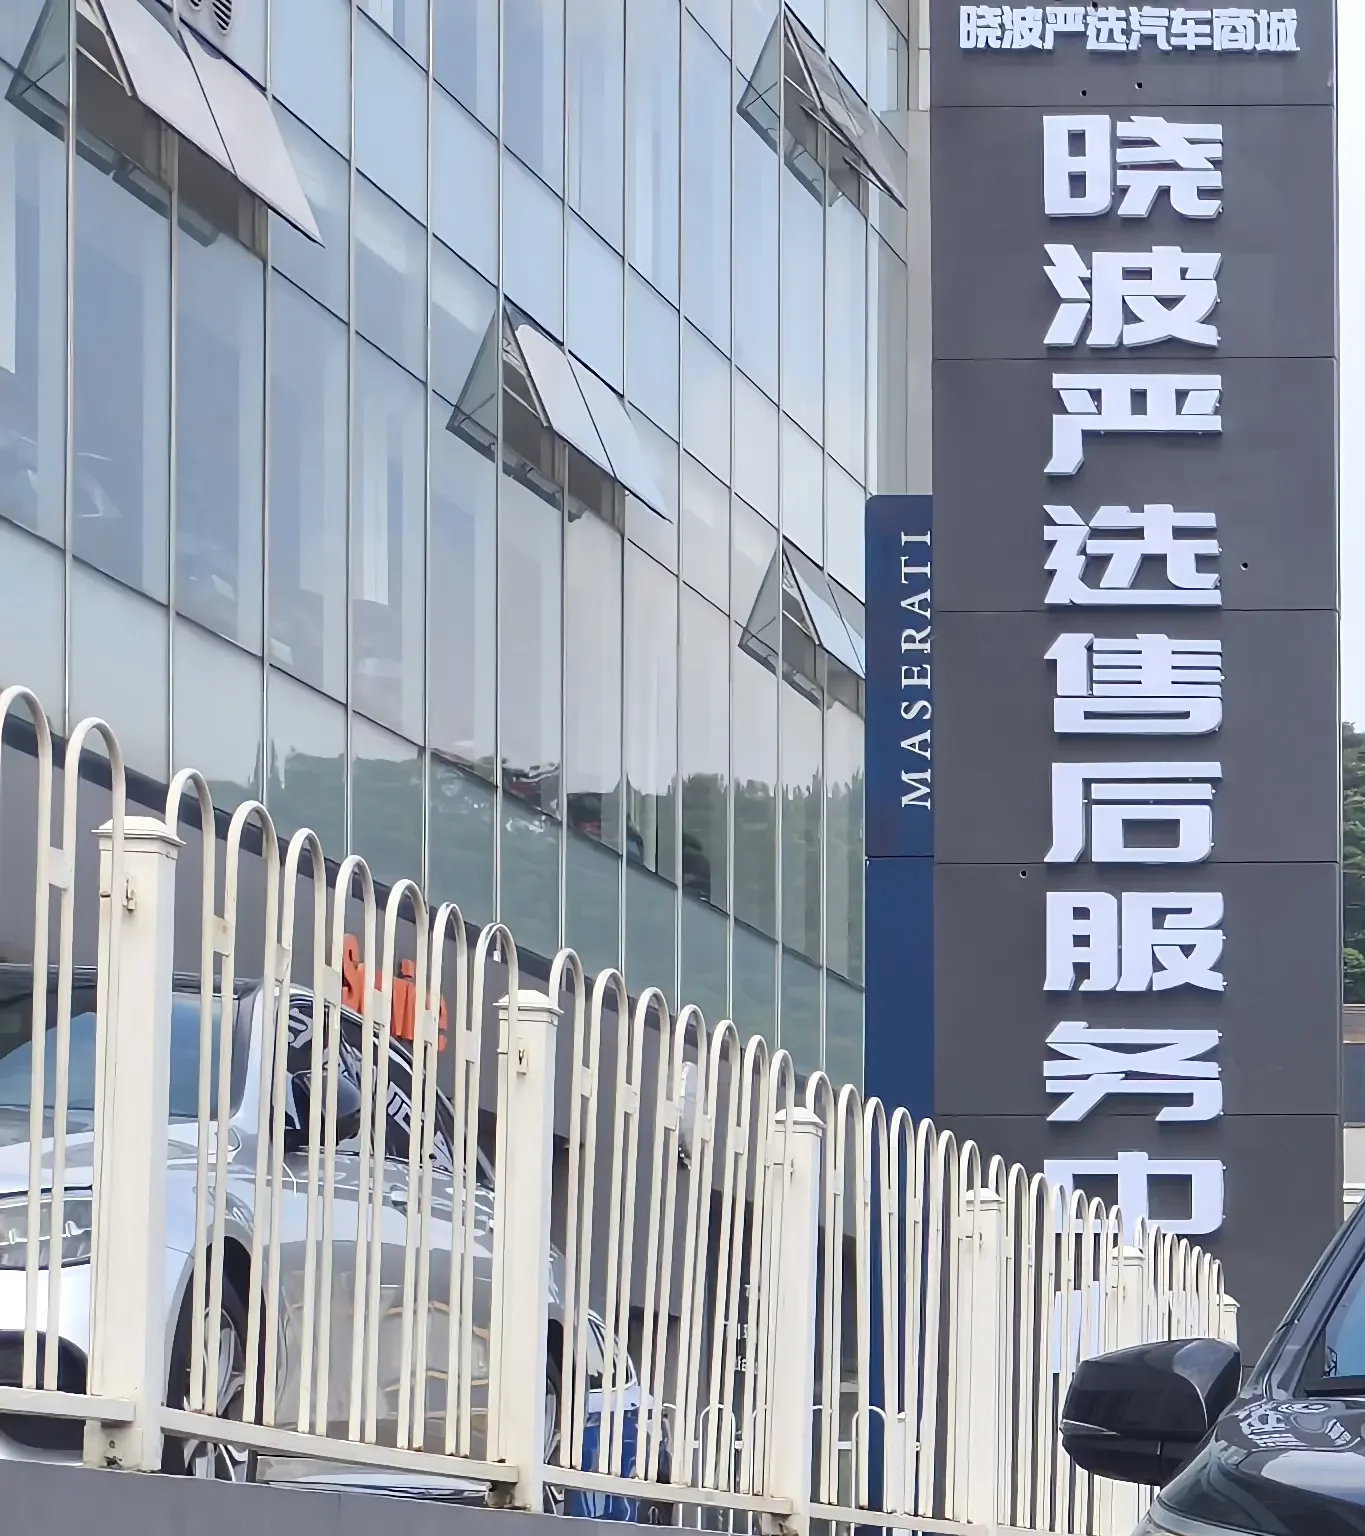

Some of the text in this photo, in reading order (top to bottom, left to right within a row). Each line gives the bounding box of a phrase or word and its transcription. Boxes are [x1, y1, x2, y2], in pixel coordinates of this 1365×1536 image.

[959, 5, 1300, 52] 晓波严选汽车商城
[901, 530, 932, 810] MASERATI
[1042, 114, 1226, 1373] 晓波严选售后服务中
